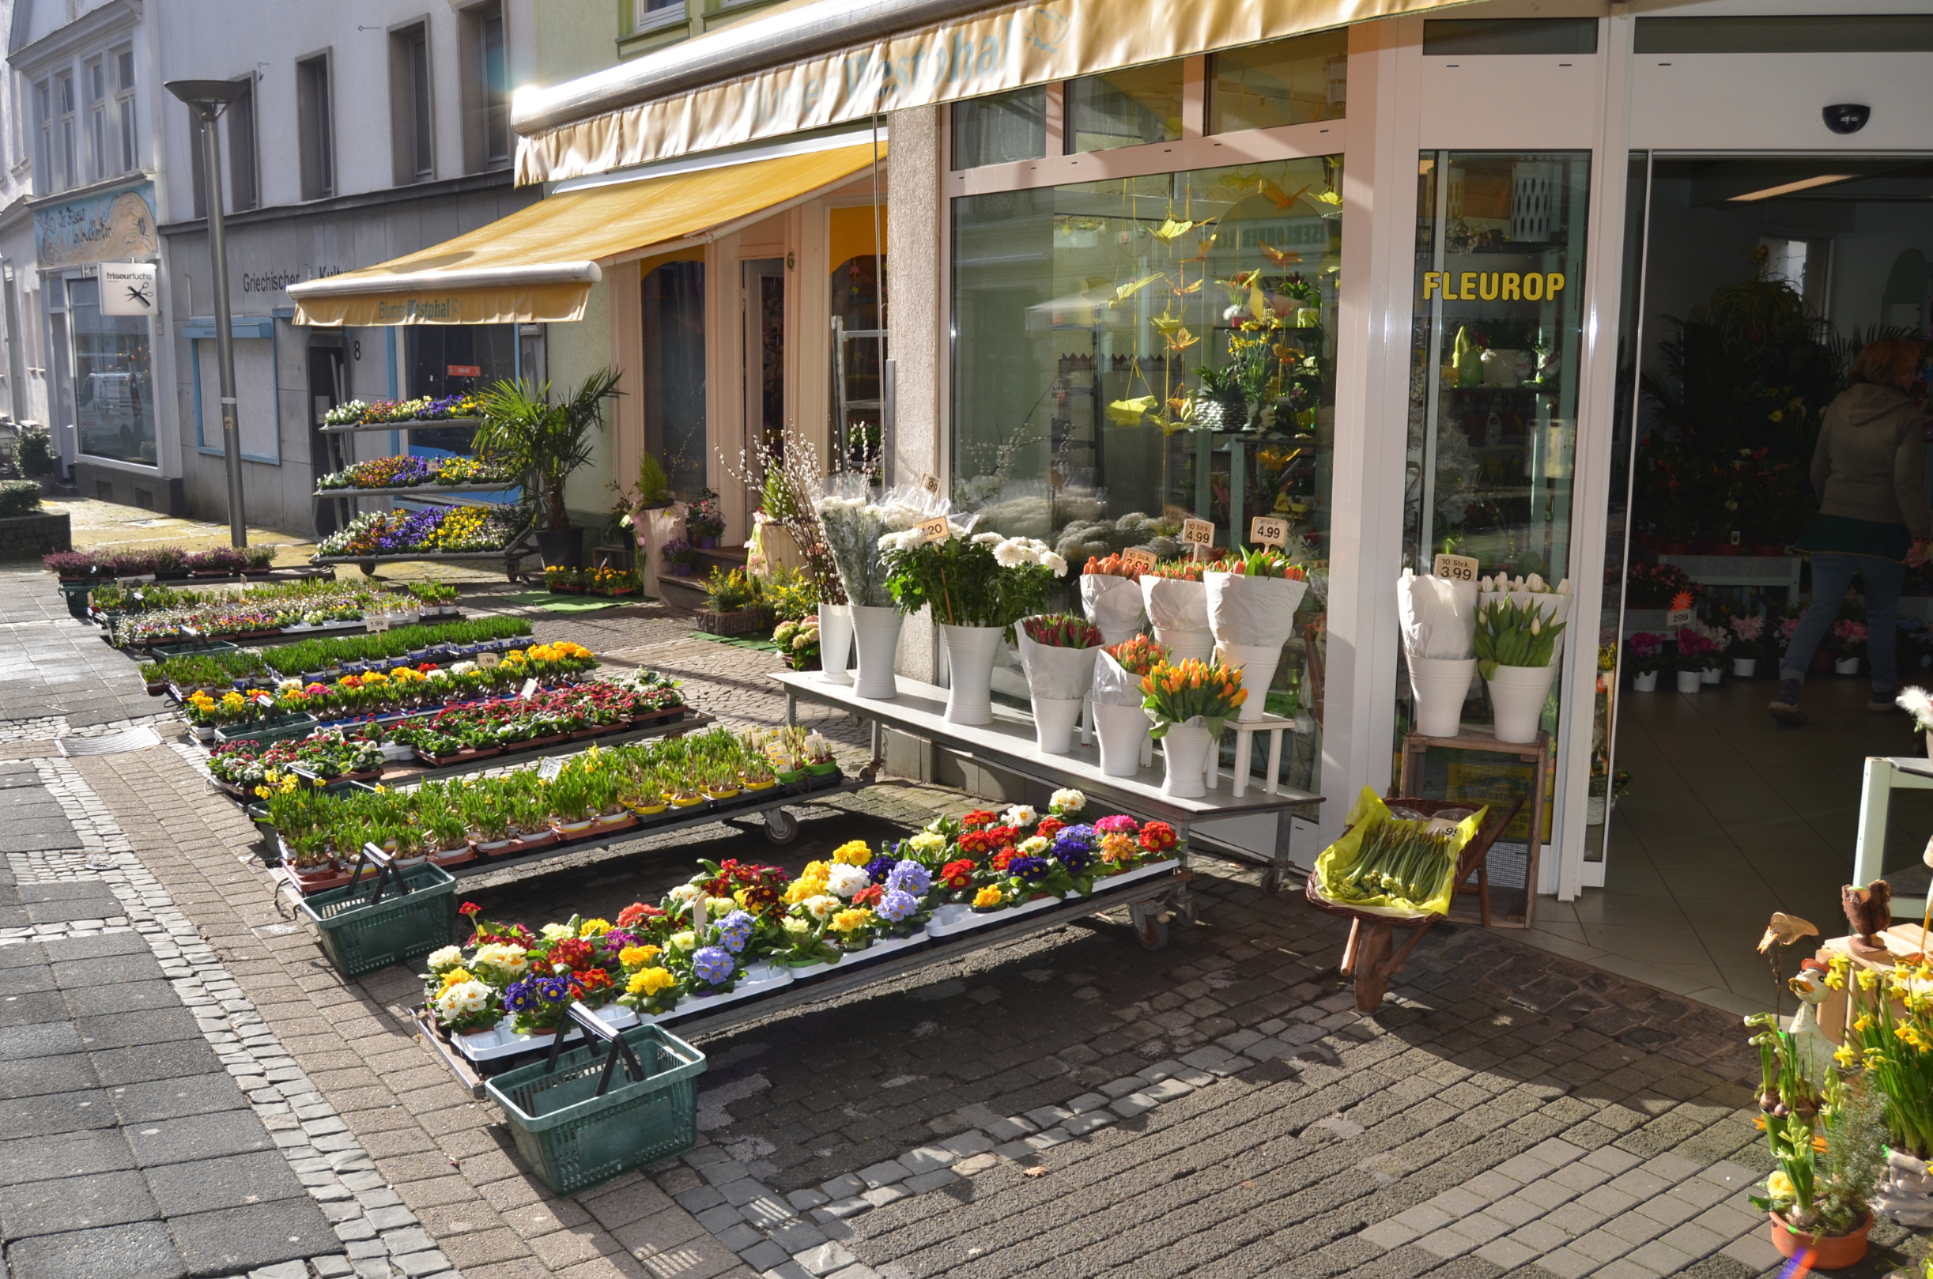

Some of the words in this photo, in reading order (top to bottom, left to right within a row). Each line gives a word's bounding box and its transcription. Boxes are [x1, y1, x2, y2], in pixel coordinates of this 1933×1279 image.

[243, 270, 300, 293] Griechischer
[1423, 271, 1565, 301] FLEUROP
[407, 298, 450, 320] Westphal
[353, 340, 361, 361] 8
[1186, 530, 1210, 544] 4.99
[1257, 525, 1280, 539] 4.99
[1452, 560, 1471, 568] Stck.
[1440, 566, 1472, 581] 3.99
[370, 620, 384, 628] 1.99
